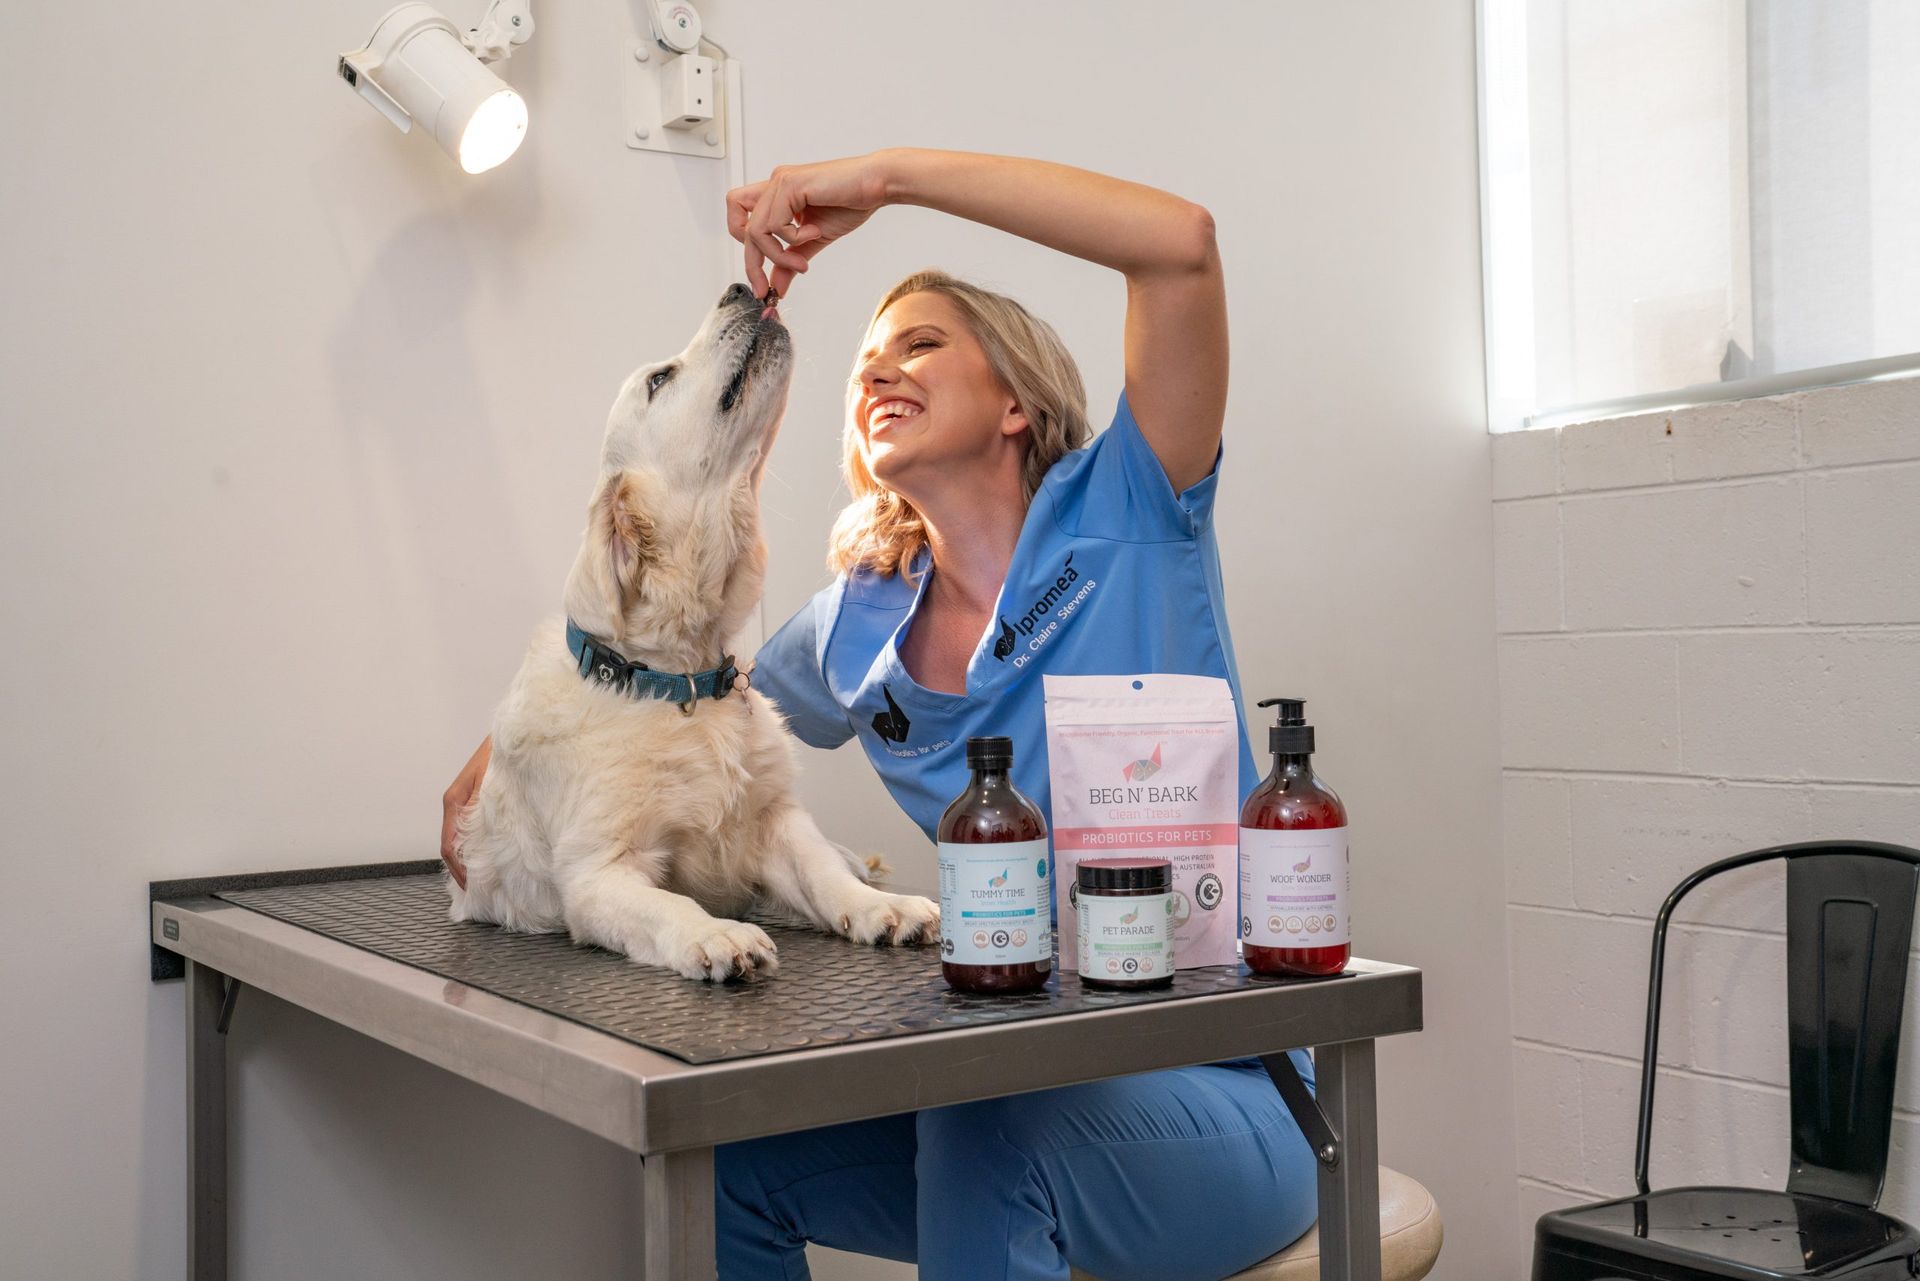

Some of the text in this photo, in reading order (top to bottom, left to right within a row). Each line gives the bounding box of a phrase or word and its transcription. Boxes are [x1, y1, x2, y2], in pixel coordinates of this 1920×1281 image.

[1013, 579, 1096, 668] Dr. Claire Stevens
[1090, 788, 1123, 804] BEG
[1149, 785, 1199, 802] BARK
[1109, 807, 1182, 820] Clean Treats
[1082, 830, 1212, 845] PROBIOTICS FOR PETS
[1180, 863, 1215, 871] AUSTRALIAN
[1270, 873, 1332, 883] WOOF WONDER
[971, 888, 1026, 899] TUMMY TIME
[1103, 925, 1155, 935] PET PARADE
